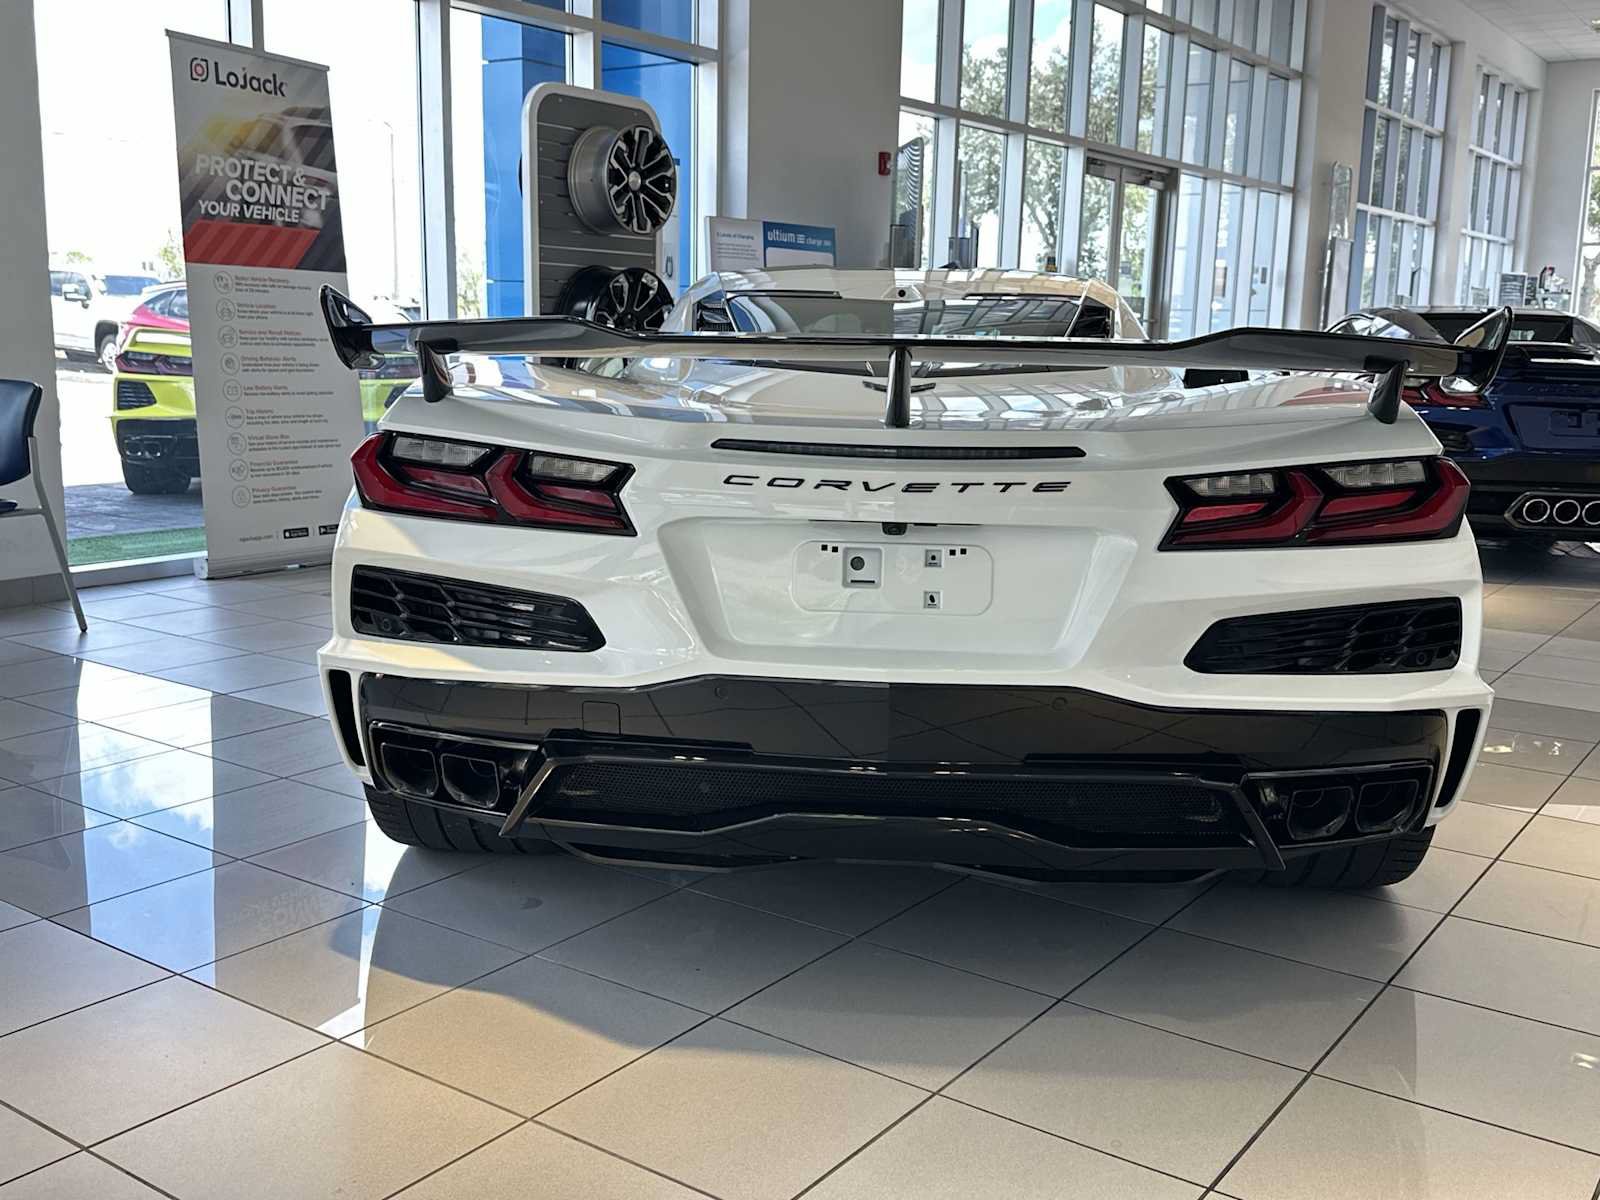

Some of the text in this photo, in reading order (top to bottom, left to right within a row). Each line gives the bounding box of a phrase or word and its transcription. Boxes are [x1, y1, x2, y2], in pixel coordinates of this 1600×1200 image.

[195, 155, 305, 186] PROTECT &
[226, 179, 330, 210] CONNECT
[199, 200, 299, 223] YOUR VEHICLE
[723, 474, 1072, 493] CORVETTE
